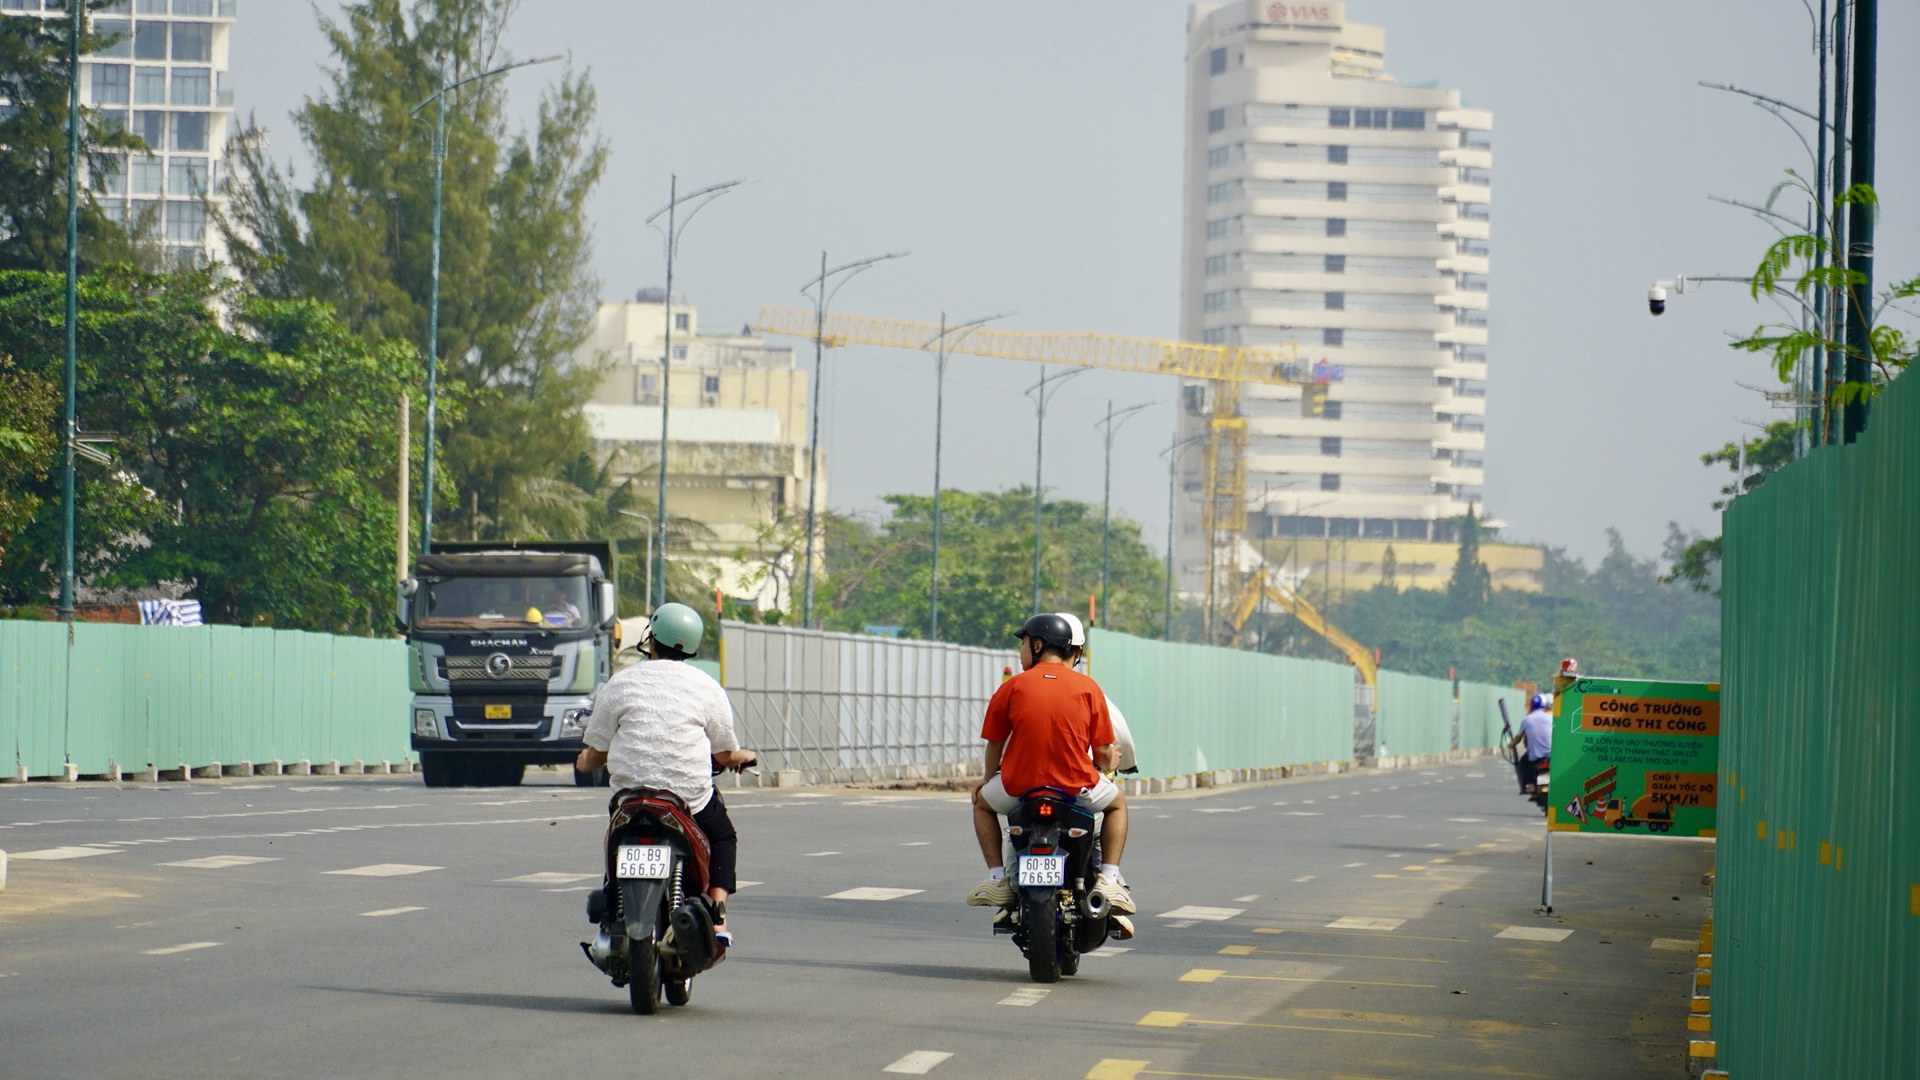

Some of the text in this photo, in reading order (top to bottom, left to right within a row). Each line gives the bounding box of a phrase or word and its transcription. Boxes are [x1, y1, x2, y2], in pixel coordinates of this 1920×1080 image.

[1290, 5, 1330, 21] VIAS
[470, 639, 528, 647] SHACMAN
[1599, 700, 1703, 716] CÔNG TRƯỜNG
[1592, 716, 1707, 731] ĐANG THI CÔNG
[1596, 737, 1612, 745] LỚN
[1672, 750, 1684, 758] XIN
[1652, 773, 1671, 781] CHÚ
[1680, 781, 1697, 792] TỐC
[1651, 792, 1699, 806] 5KM/H
[626, 848, 661, 861] 60-B9
[620, 862, 666, 876] 566.67
[1026, 857, 1057, 870] 60-B9
[1021, 871, 1061, 884] 766.55
